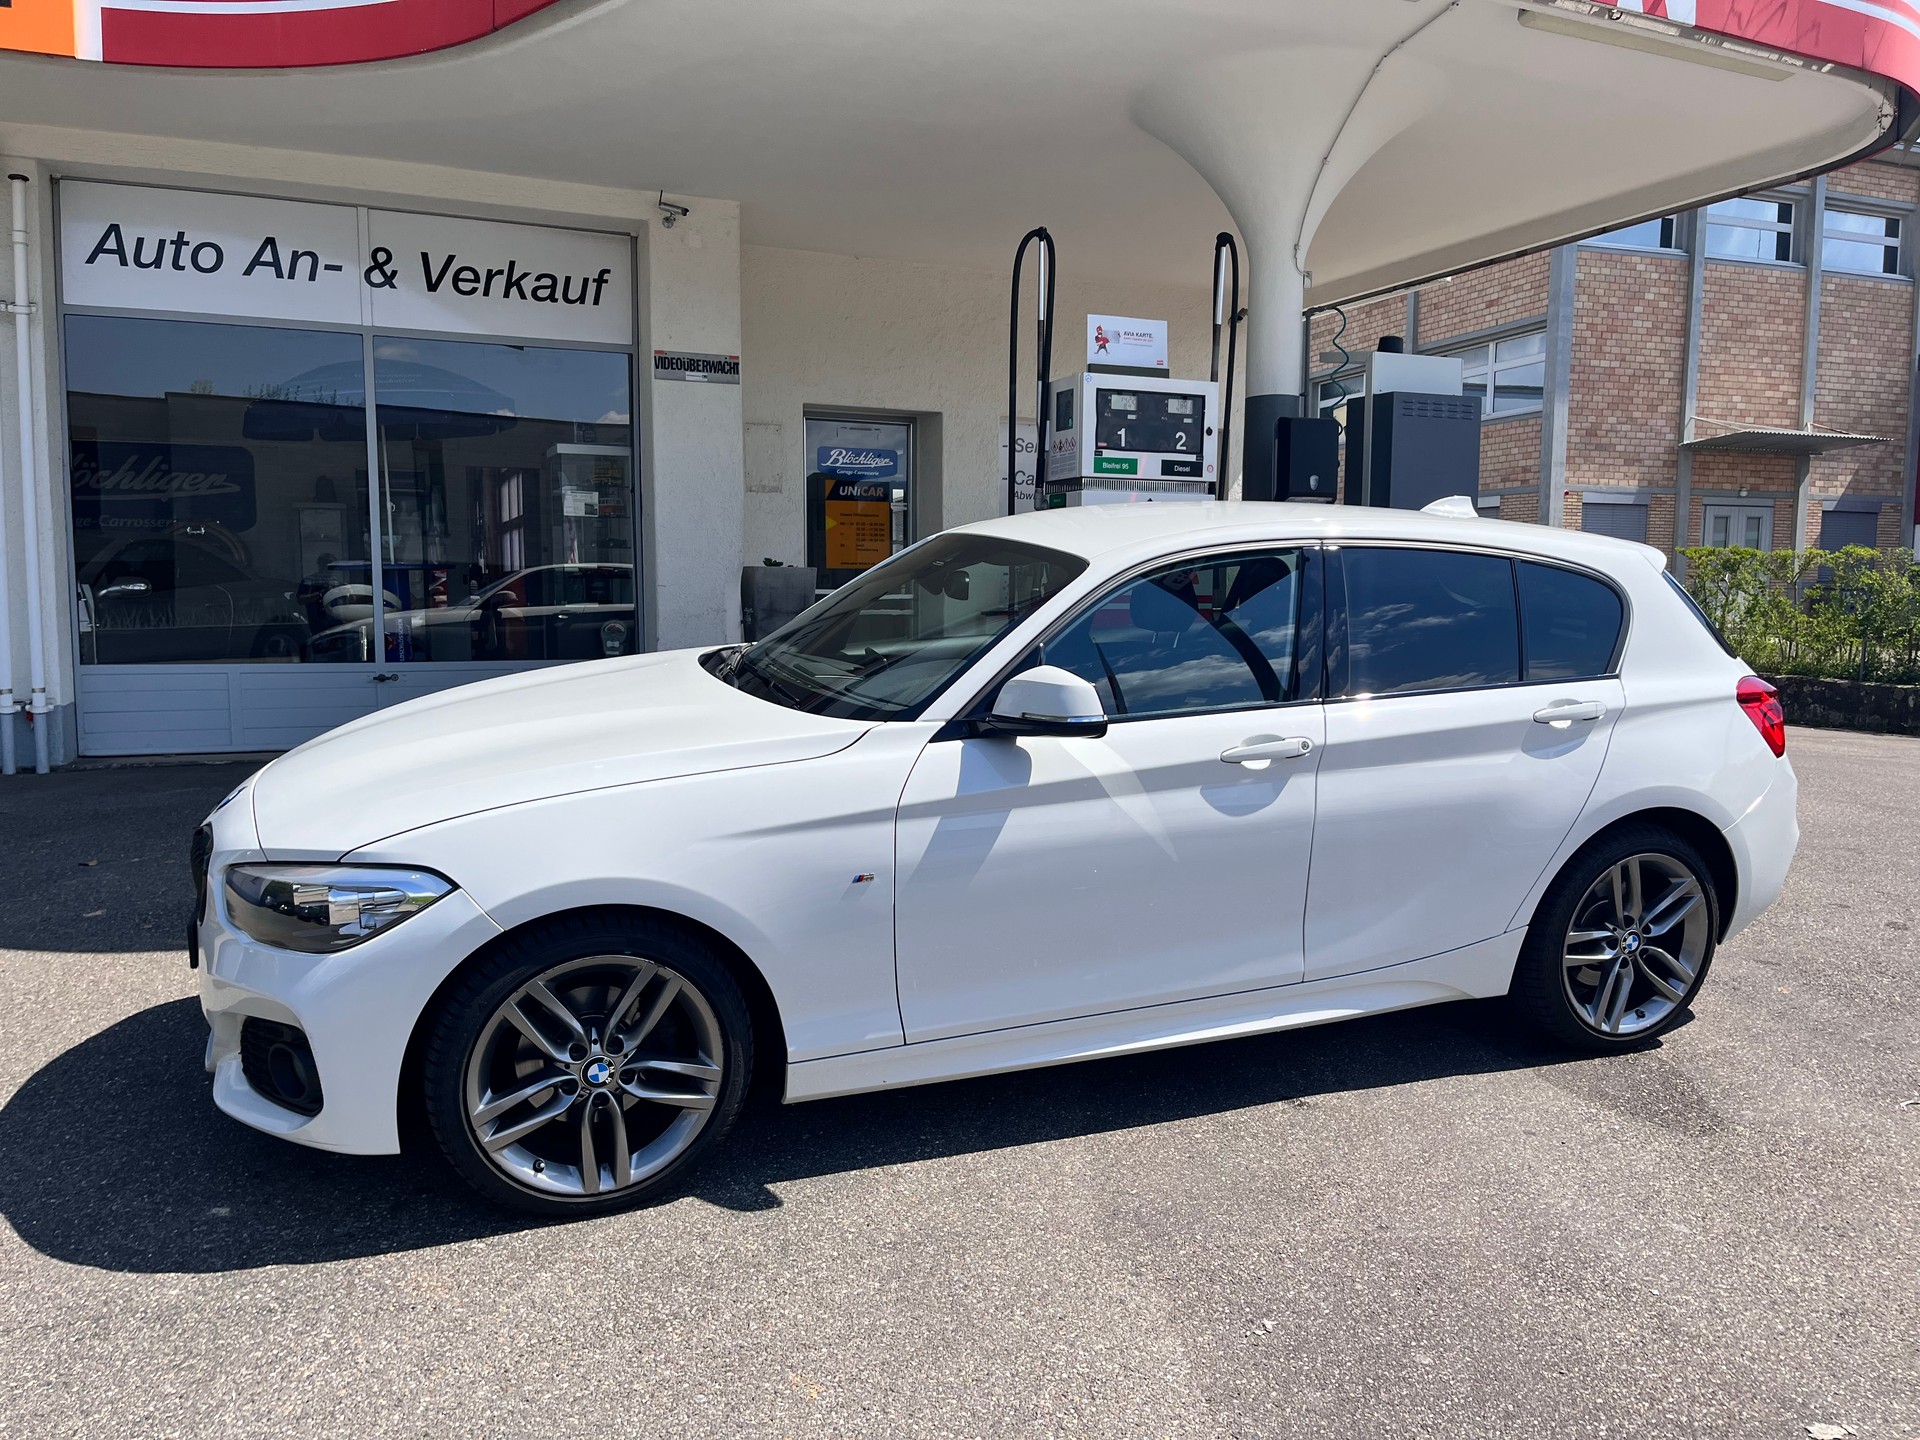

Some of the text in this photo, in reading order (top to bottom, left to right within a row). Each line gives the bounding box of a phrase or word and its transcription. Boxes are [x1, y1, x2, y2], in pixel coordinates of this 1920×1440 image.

[85, 222, 612, 307] Auto An- & Verkauf
[1117, 428, 1126, 447] 1
[1175, 431, 1187, 451] 2
[821, 448, 894, 469] Blöchliger
[1102, 461, 1129, 470] Bleifrei 95
[1015, 490, 1035, 501] Abw
